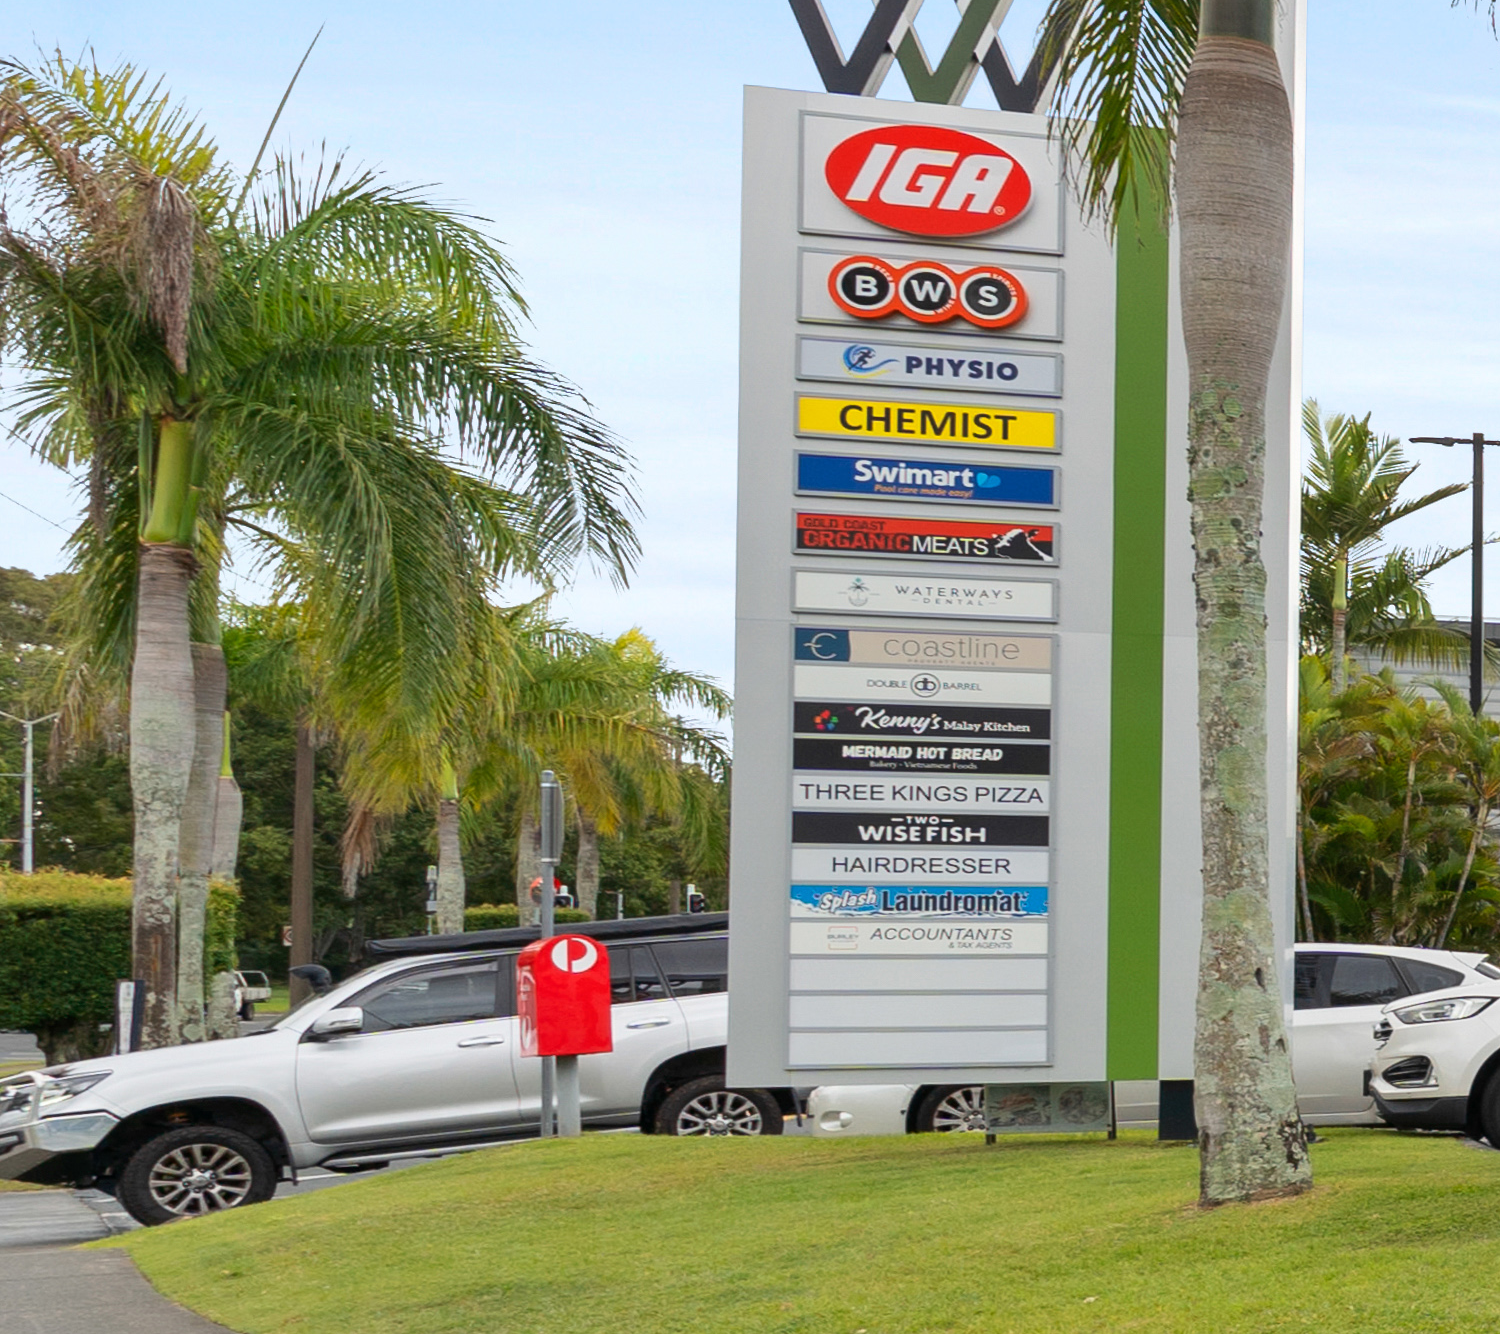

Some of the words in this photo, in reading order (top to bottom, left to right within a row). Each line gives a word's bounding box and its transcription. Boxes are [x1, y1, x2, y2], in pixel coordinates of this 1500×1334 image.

[845, 142, 1014, 214] IGA
[905, 355, 1019, 381] PHYSIO
[839, 404, 1018, 440] CHEMIST
[854, 460, 974, 487] Swimart
[804, 518, 839, 529] GOLD
[843, 519, 887, 531] COAST
[803, 530, 910, 551] ORGANIC
[913, 535, 989, 555] MEATS
[895, 585, 1014, 600] WATERWAYS
[923, 598, 984, 606] DENTAL
[884, 637, 1020, 660] coastline
[867, 679, 908, 689] DOUBLE
[943, 681, 982, 691] BARREL
[855, 706, 942, 734] Kenny's
[943, 720, 981, 732] Malay
[983, 722, 1030, 732] Kitchen
[842, 745, 911, 759] MERMAID
[916, 747, 947, 760] HOT
[951, 749, 1003, 761] BREAD
[799, 784, 885, 801] THREE
[892, 785, 968, 802] KINGS
[975, 786, 1043, 804] PIZZA
[906, 816, 940, 825] TWO
[858, 825, 921, 842] WISE
[926, 826, 987, 843] FISH
[832, 857, 1011, 874] HAIRDRESSER
[820, 888, 877, 911] Splash
[882, 890, 1023, 913] Laundromat
[870, 928, 1013, 941] ACCOUNTANTS
